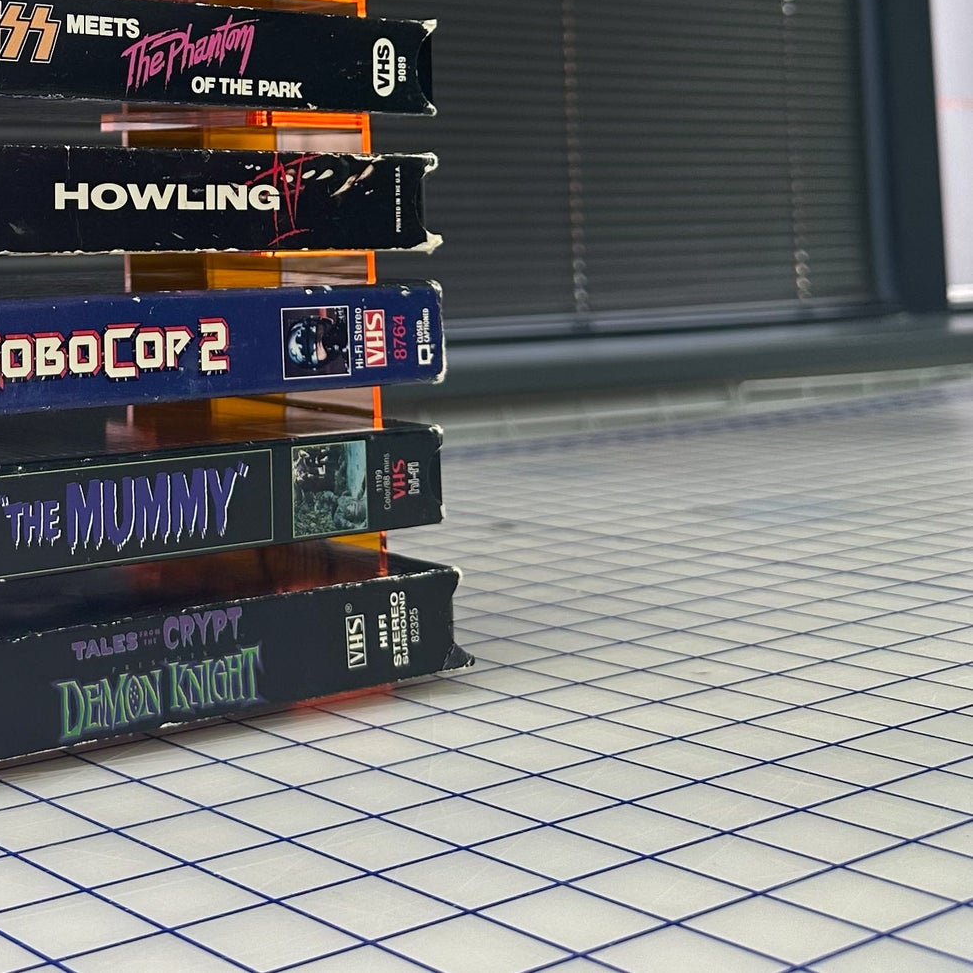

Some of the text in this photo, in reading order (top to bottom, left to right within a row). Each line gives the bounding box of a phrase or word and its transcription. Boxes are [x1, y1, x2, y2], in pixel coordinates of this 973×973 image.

[66, 13, 140, 39] MEETS
[121, 14, 260, 96] The Phantom
[376, 44, 391, 91] VHS
[397, 56, 407, 82] 9089
[191, 76, 303, 99] OF THE PARK
[54, 182, 280, 211] HOWLING
[395, 197, 401, 206] IN
[198, 317, 231, 376] 2
[353, 307, 364, 369] Hi-Fi Stereo
[364, 311, 386, 366] VHS
[392, 314, 408, 360] 8764
[422, 308, 430, 343] CAPTIONED
[375, 469, 383, 492] 11199
[383, 452, 391, 473] mins
[392, 458, 406, 500] VHS
[71, 606, 243, 661] TALES FROM THE CRYPT
[347, 616, 365, 666] VHS
[378, 613, 388, 648] HI FI
[390, 591, 402, 667] STEREO
[399, 590, 409, 665] SURROUND
[409, 607, 420, 642] 82325
[57, 644, 261, 738] DEMON KNIGHT
